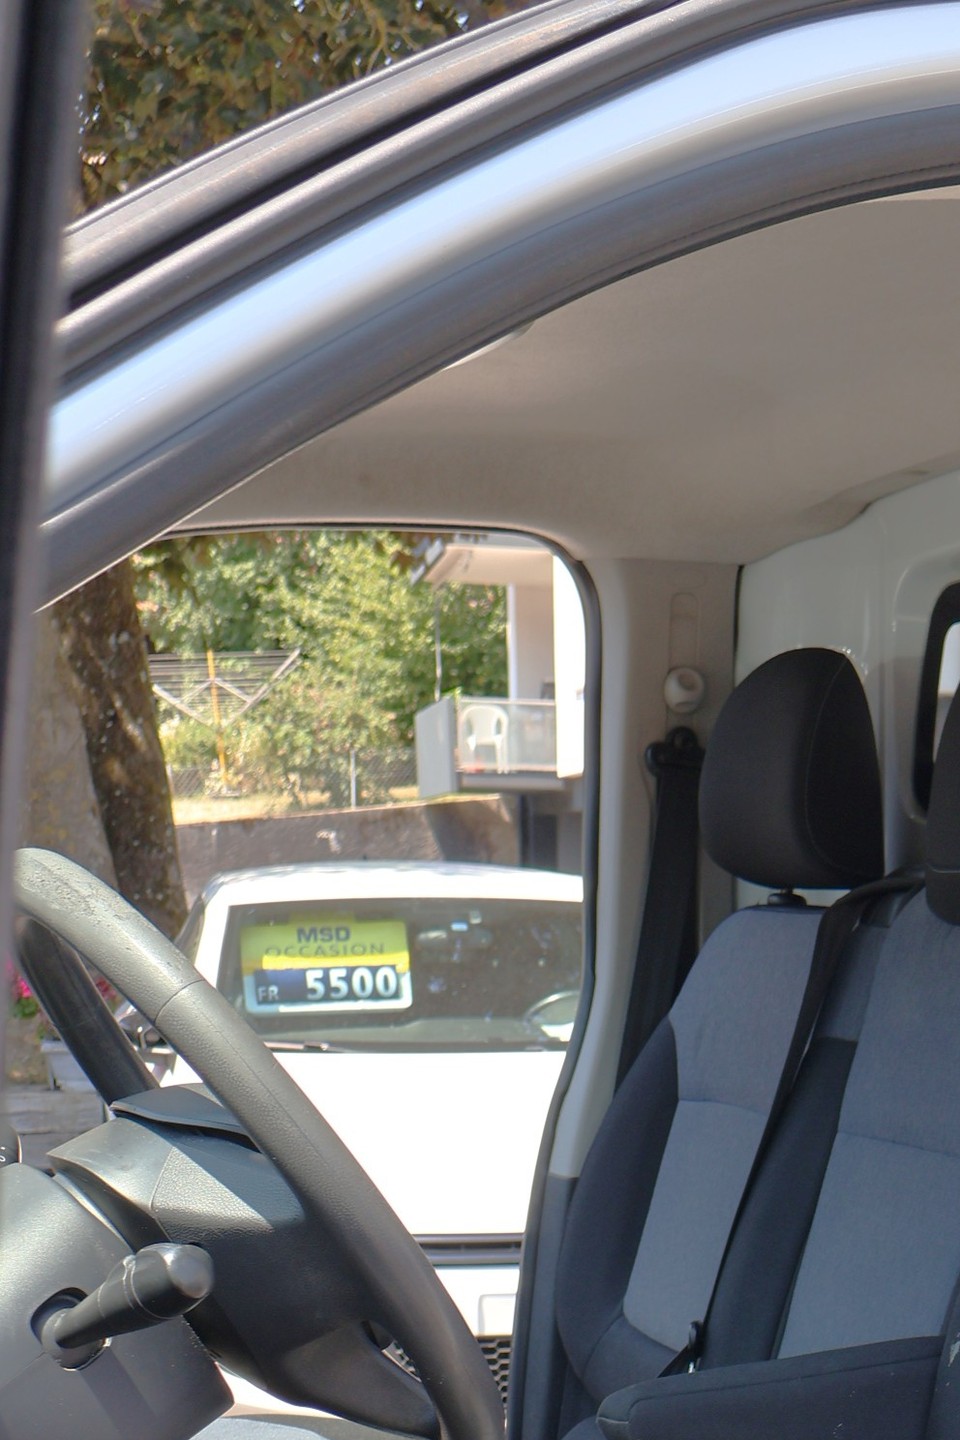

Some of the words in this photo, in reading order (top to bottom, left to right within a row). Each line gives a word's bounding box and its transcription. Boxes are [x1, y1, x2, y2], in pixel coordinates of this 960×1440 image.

[297, 926, 351, 943] MSD
[265, 943, 385, 959] OCCASION
[257, 985, 280, 1001] FR
[305, 966, 397, 1000] 5500
